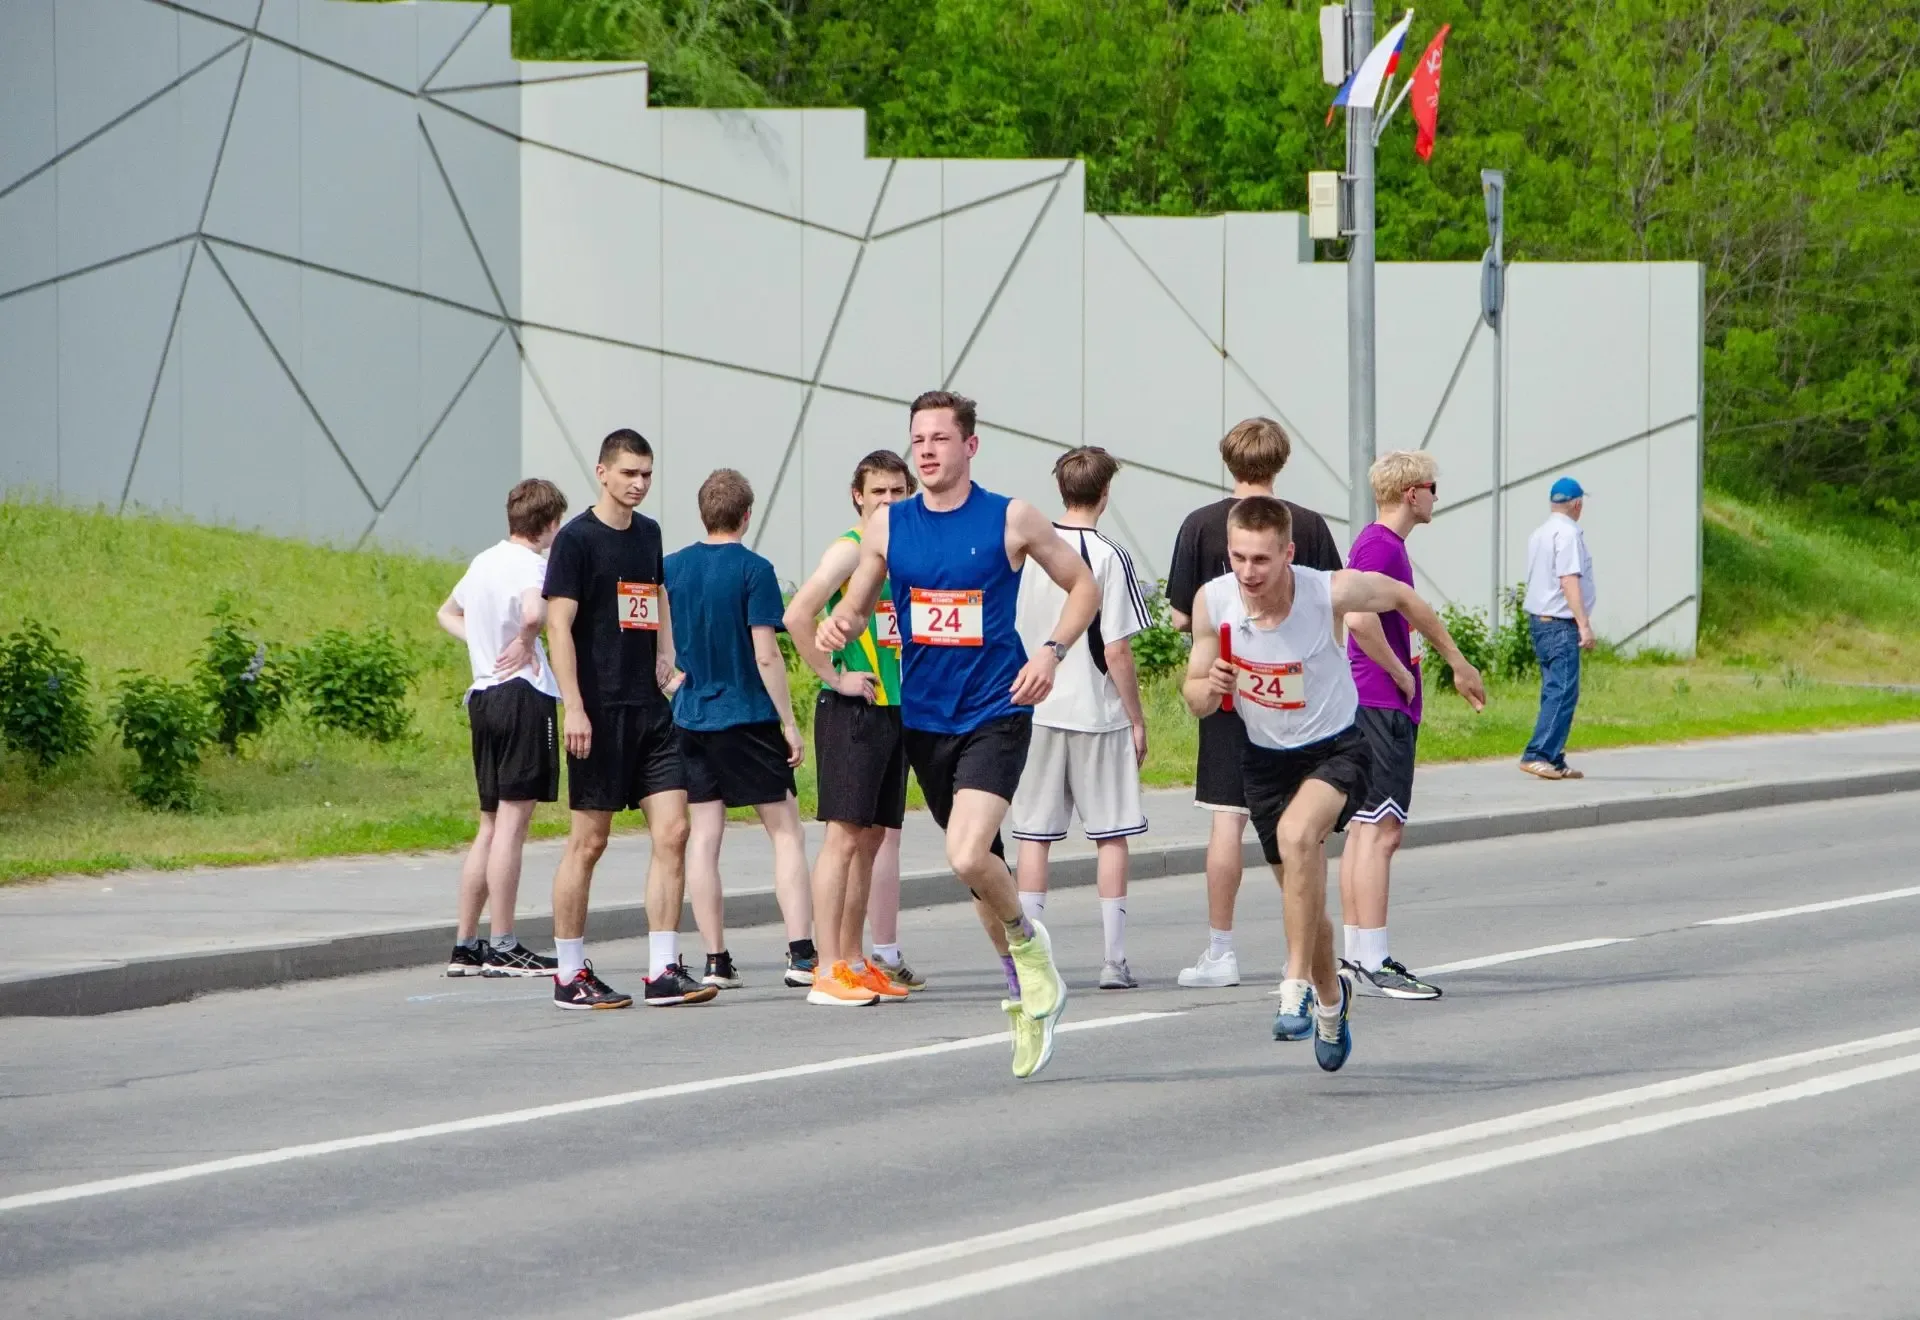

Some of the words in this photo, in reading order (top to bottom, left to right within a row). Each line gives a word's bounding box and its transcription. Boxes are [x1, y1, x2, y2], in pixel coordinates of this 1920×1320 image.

[629, 597, 648, 619] 25
[928, 607, 962, 632] 24
[888, 614, 897, 635] 2
[1250, 674, 1284, 698] 24
